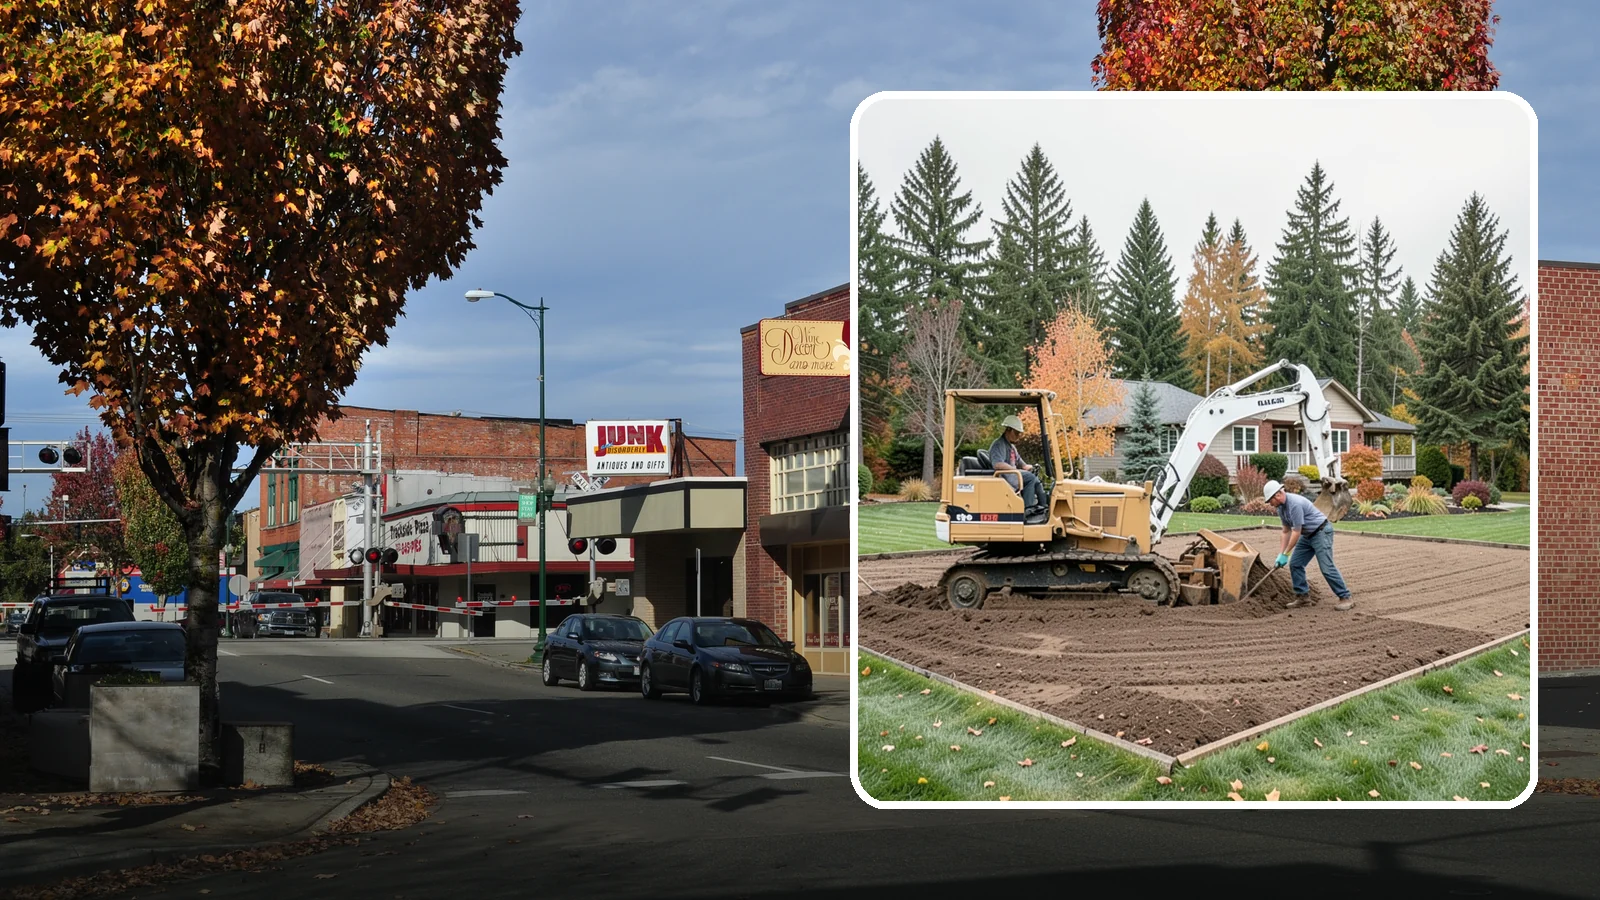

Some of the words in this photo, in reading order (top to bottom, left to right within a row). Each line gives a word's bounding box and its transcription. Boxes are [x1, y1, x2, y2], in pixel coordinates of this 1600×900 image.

[595, 425, 665, 457] JUNK
[607, 446, 646, 454] DISORDERLY
[597, 461, 628, 470] ANTIQUES
[631, 461, 644, 470] AND
[647, 460, 665, 469] GIFTS
[590, 476, 608, 491] SING
[352, 498, 364, 511] CRO
